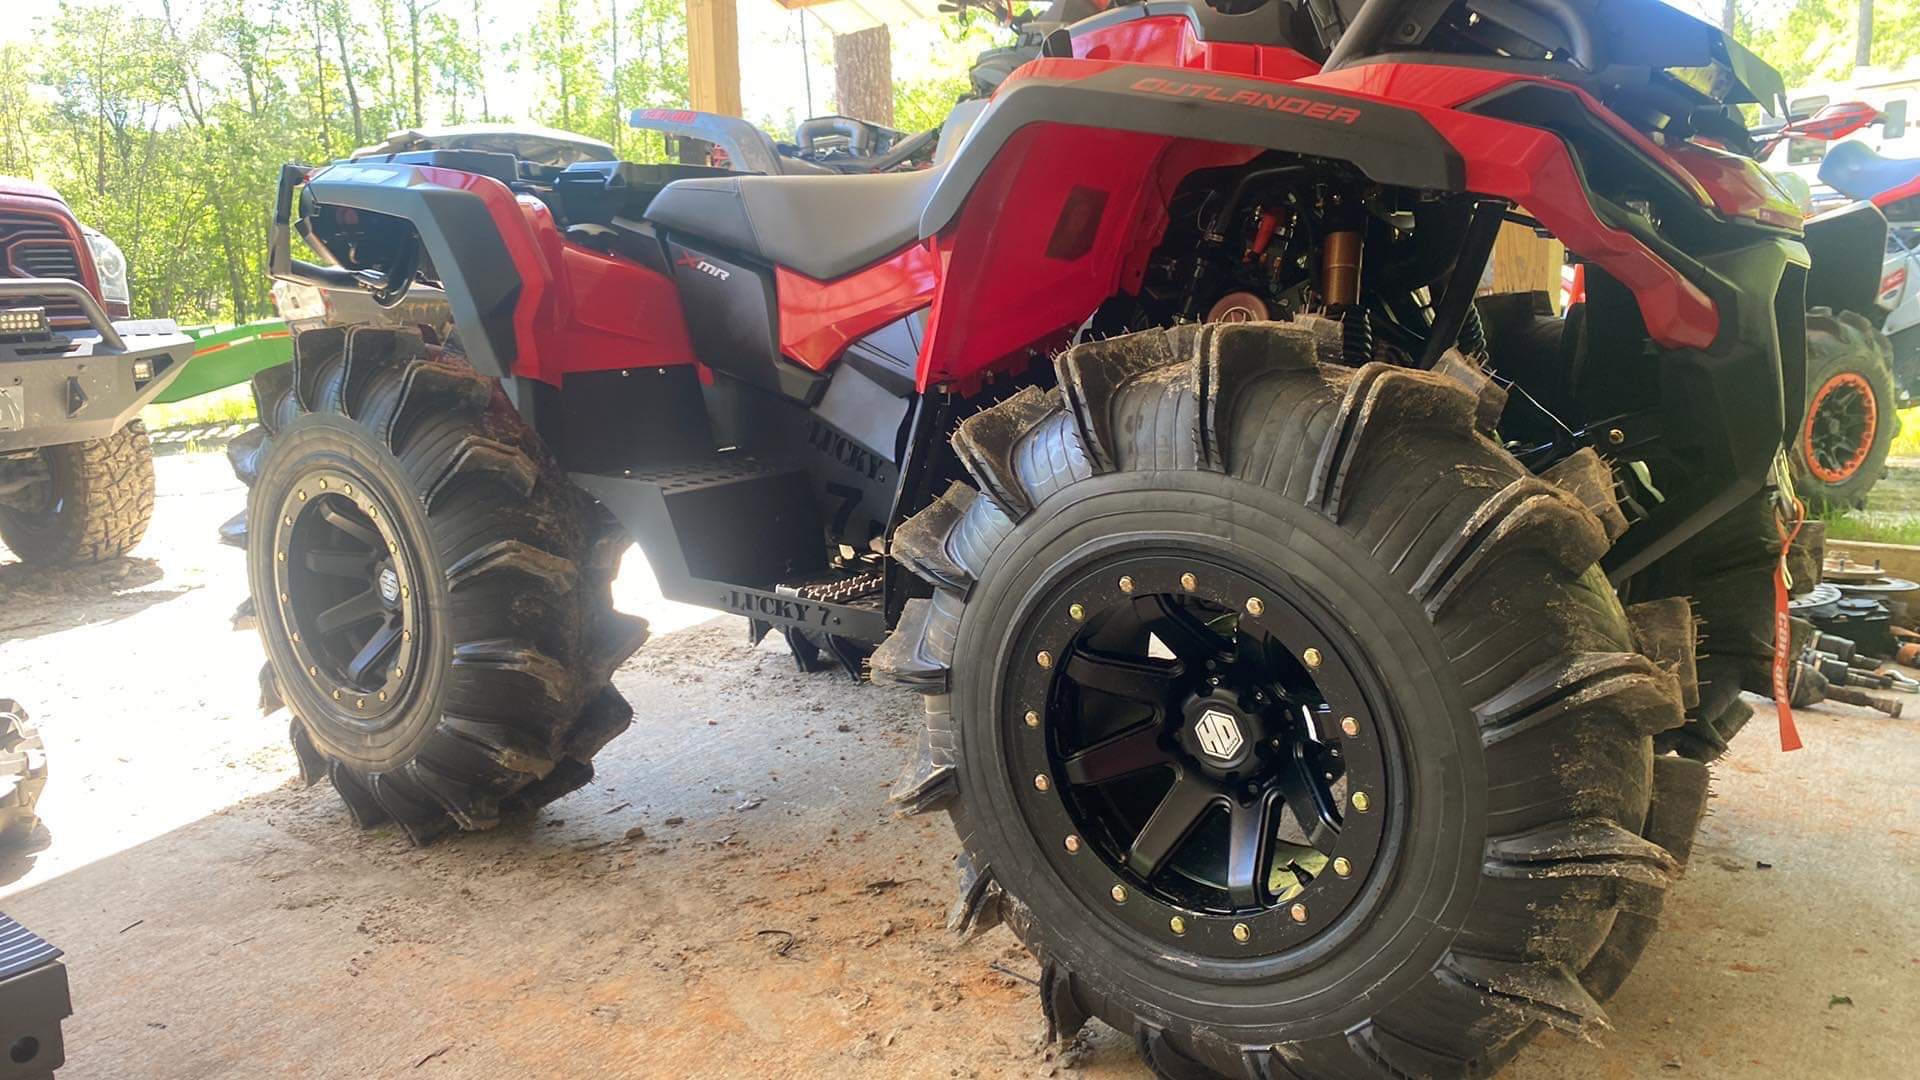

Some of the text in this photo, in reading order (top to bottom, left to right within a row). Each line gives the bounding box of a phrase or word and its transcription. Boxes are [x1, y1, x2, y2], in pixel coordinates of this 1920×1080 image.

[1129, 78, 1361, 124] OUTLANDER
[808, 424, 882, 479] LUCKY
[826, 482, 862, 537] 7
[730, 590, 833, 626] LUCKY 7
[1197, 712, 1241, 757] HD
